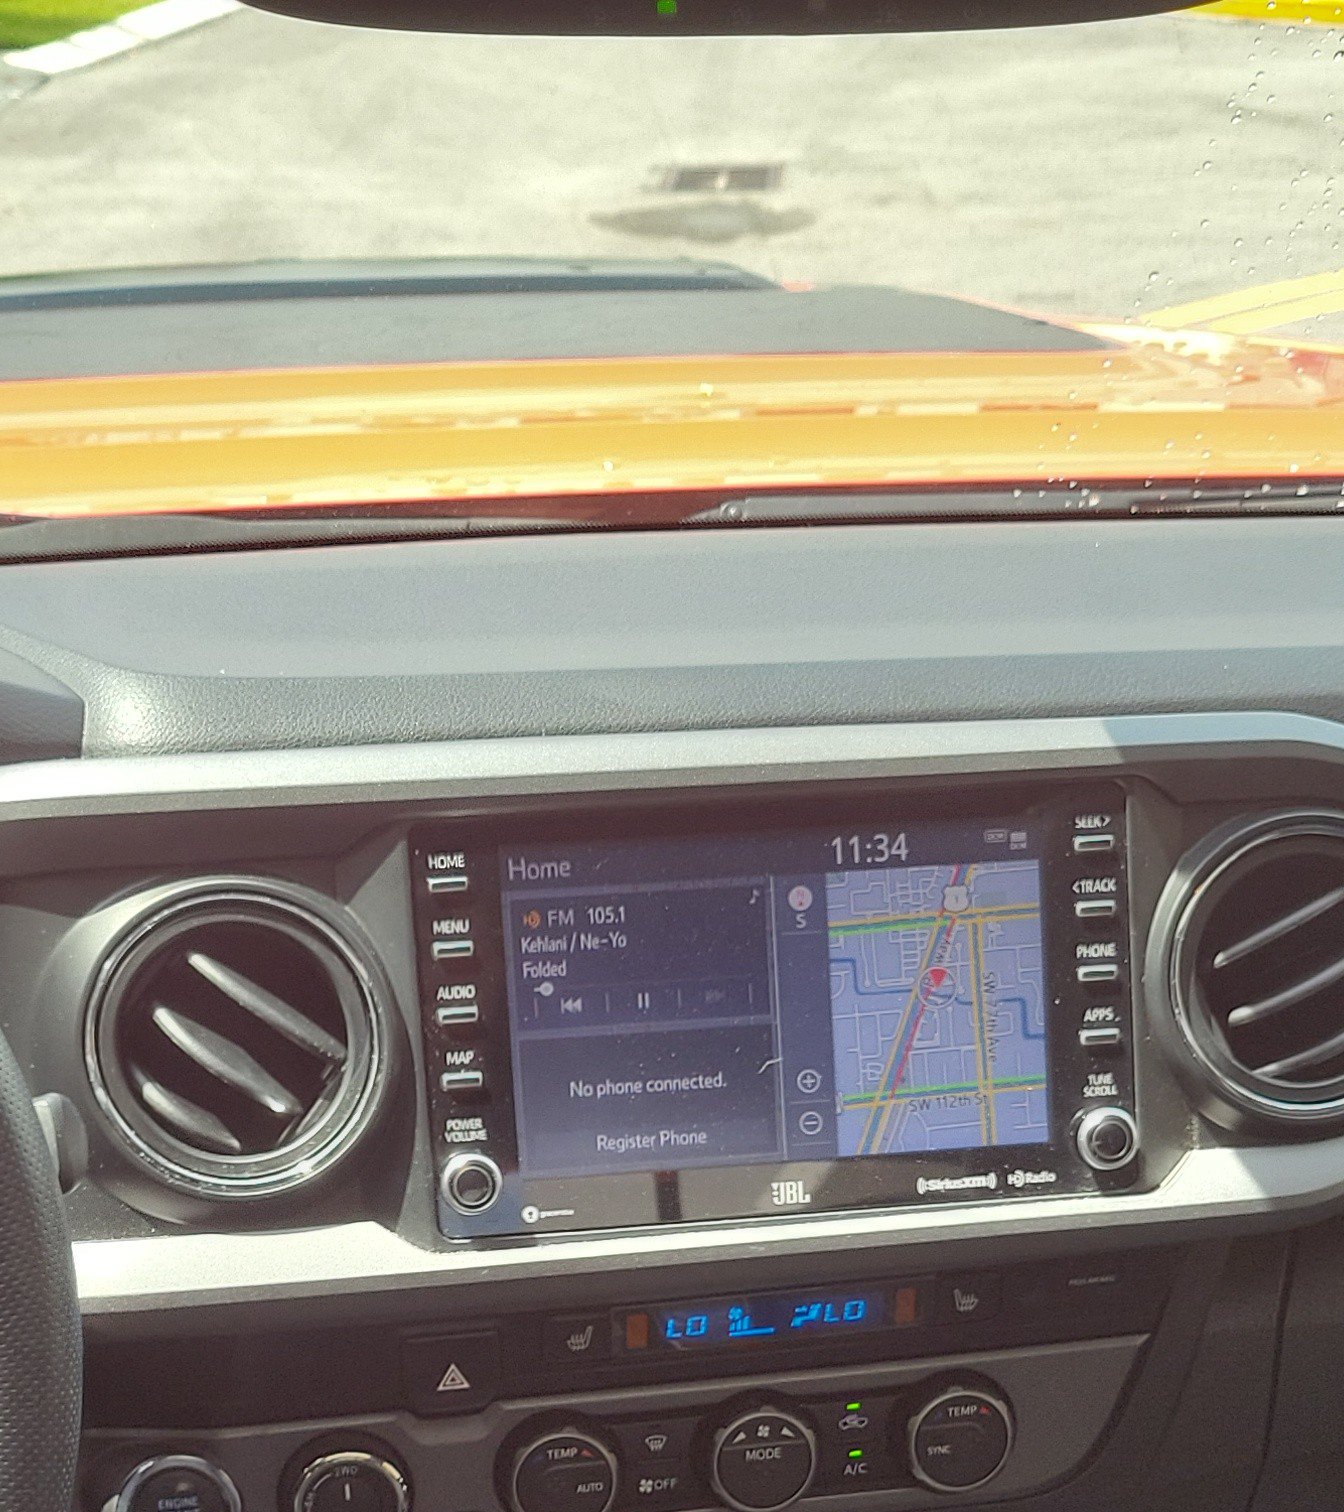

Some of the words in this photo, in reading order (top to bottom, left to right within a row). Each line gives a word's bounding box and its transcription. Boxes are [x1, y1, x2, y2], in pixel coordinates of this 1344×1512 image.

[829, 832, 909, 865] 11:34
[427, 852, 465, 870] HOME
[508, 856, 572, 882] Home
[547, 908, 575, 927] FM
[586, 905, 626, 926] 105.1
[432, 918, 470, 935] MENU
[521, 934, 567, 955] Kehlani
[580, 931, 628, 951] Ne-Yo
[1076, 943, 1118, 958] PHONE
[522, 960, 567, 979] Folded
[437, 985, 476, 1000] AUDIO
[1083, 1007, 1115, 1022] APPS
[446, 1051, 476, 1066] MAP
[570, 1079, 593, 1098] No
[596, 1078, 643, 1099] phone
[645, 1071, 727, 1094] connected.
[1087, 1074, 1114, 1086] TUNE
[908, 1099, 931, 1113] SW
[445, 1117, 483, 1131] POWER
[596, 1133, 656, 1153] Register
[659, 1129, 707, 1147] Phone
[771, 1180, 811, 1206] JBL
[947, 1405, 978, 1418] TEMP
[547, 1447, 578, 1460] TEMP
[745, 1446, 782, 1461] MODE
[927, 1444, 952, 1457] SYNC
[844, 1462, 868, 1476] A/C
[576, 1481, 605, 1494] AUTO
[654, 1477, 678, 1490] OFF
